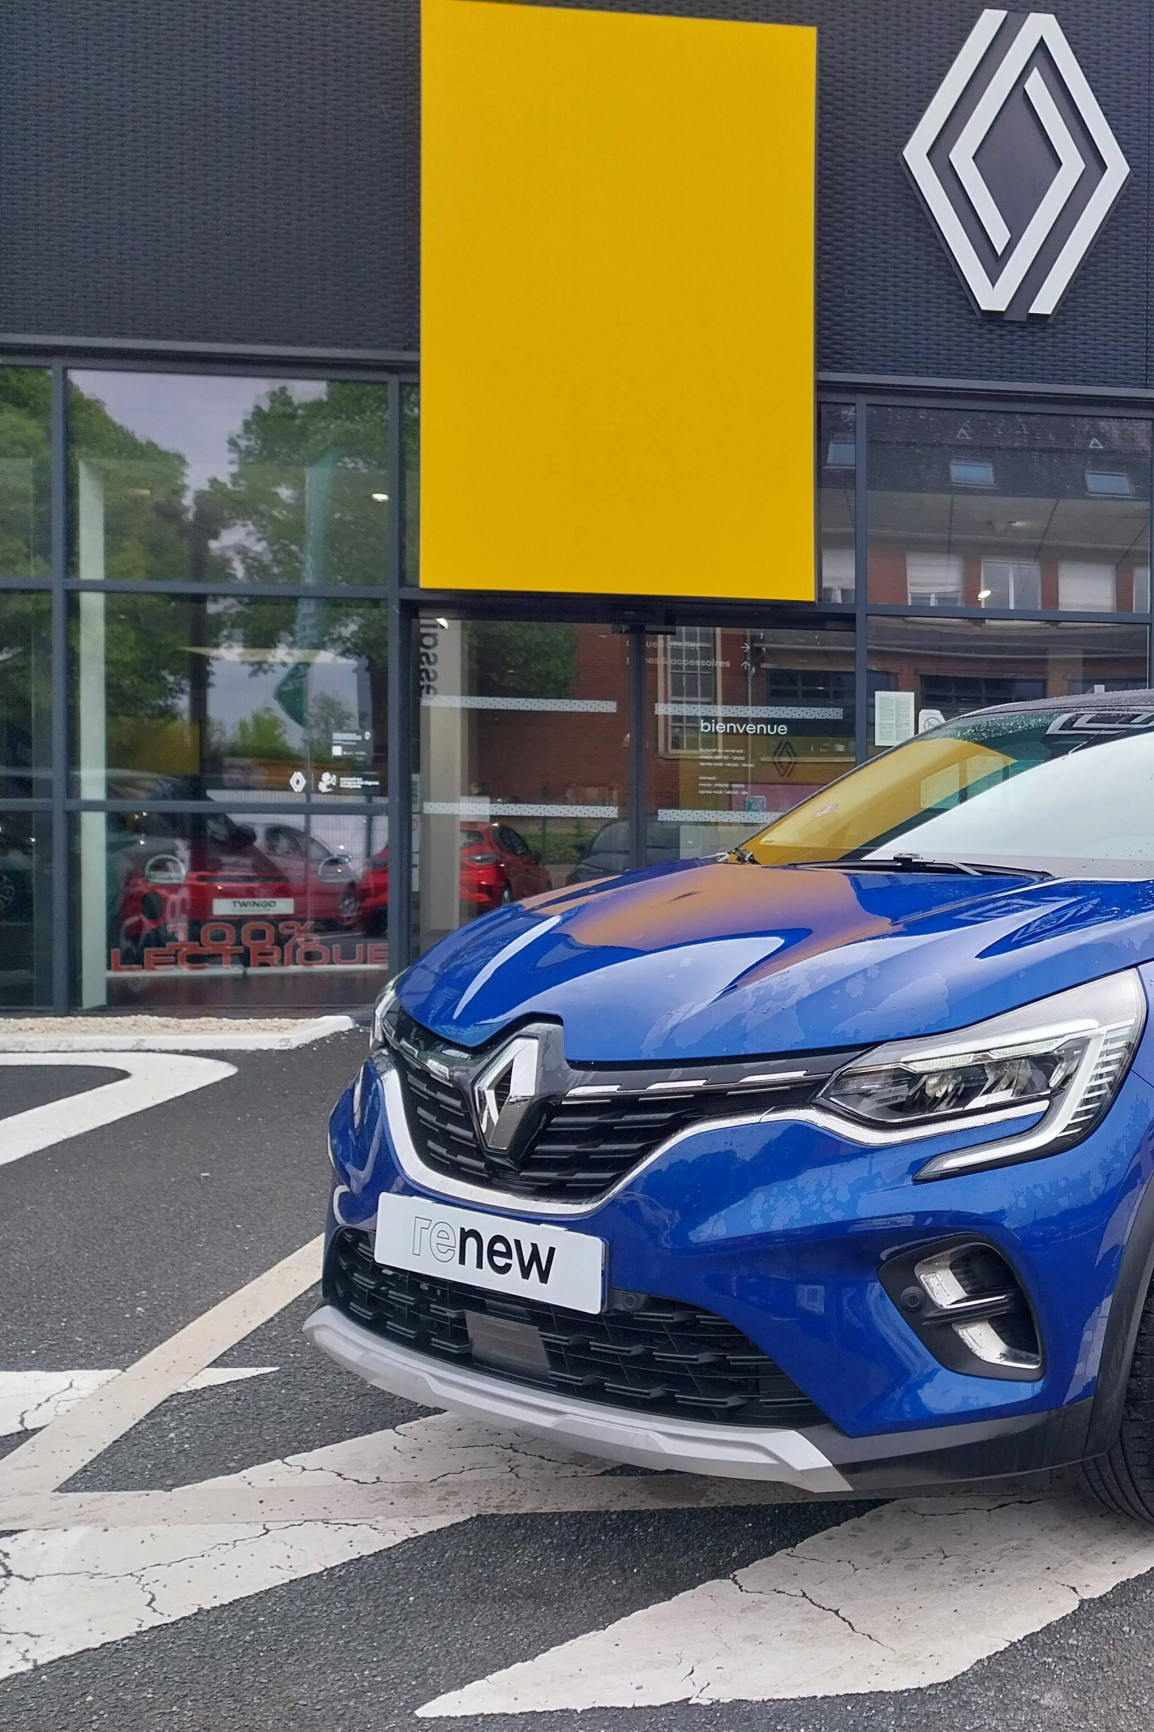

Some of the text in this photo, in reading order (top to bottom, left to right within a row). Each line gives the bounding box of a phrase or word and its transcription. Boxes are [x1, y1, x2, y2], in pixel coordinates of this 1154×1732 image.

[670, 657, 731, 668] accessoires
[700, 719, 788, 735] bienvenue
[232, 900, 277, 908] TWINGO
[165, 920, 321, 951] 100%
[110, 943, 388, 973] LECTRIQUE
[412, 1216, 557, 1285] renew
